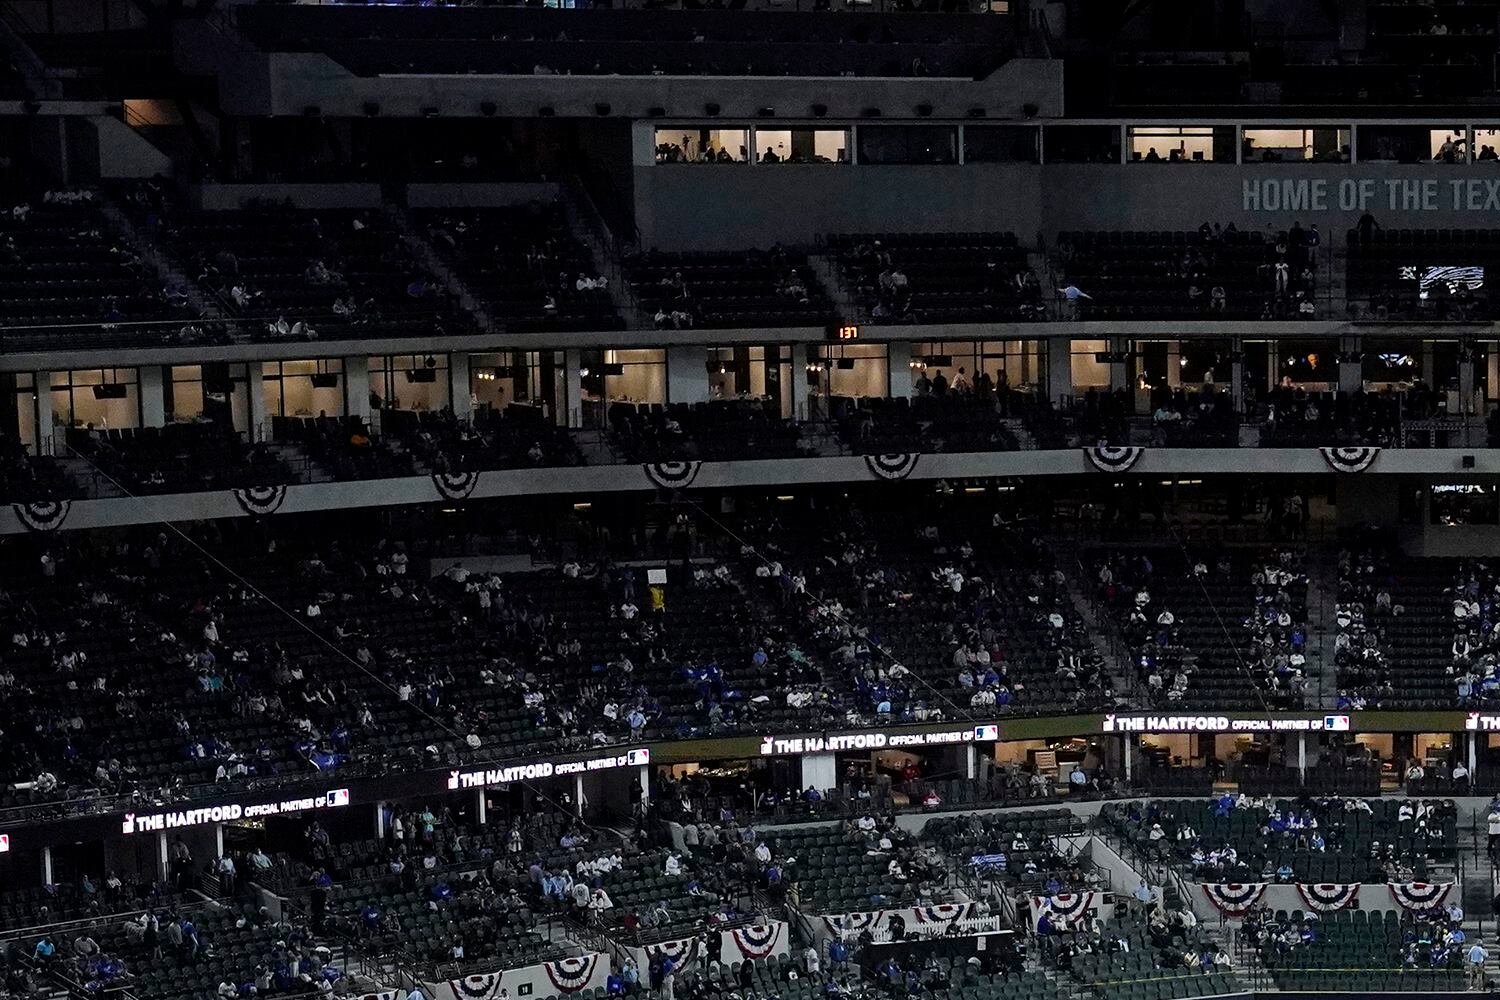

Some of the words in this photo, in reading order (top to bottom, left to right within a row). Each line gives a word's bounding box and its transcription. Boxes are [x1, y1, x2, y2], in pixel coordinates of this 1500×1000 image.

[1243, 179, 1328, 211] HOME
[1339, 179, 1375, 211] OF
[1384, 179, 1438, 210] THE
[1117, 717, 1145, 730] THE
[1147, 717, 1229, 730] HARTFORD
[1232, 720, 1270, 730] OFFICIAL
[1272, 720, 1309, 729] PARTNER
[1311, 720, 1323, 729] OF
[775, 741, 803, 753] THE
[889, 735, 925, 745] OFFICIAL
[926, 732, 960, 743] PARTNER
[962, 731, 974, 741] OF
[460, 773, 484, 787] THE
[486, 763, 553, 784] HARTFORD
[555, 762, 586, 775] OFFICIAL
[587, 757, 616, 770] PARTNER
[618, 756, 627, 766] OF
[136, 815, 164, 831] THE
[166, 804, 241, 828] HARTFORD
[245, 803, 279, 817] OFFICIAL
[281, 798, 314, 812] PARTNER
[315, 797, 326, 807] OF
